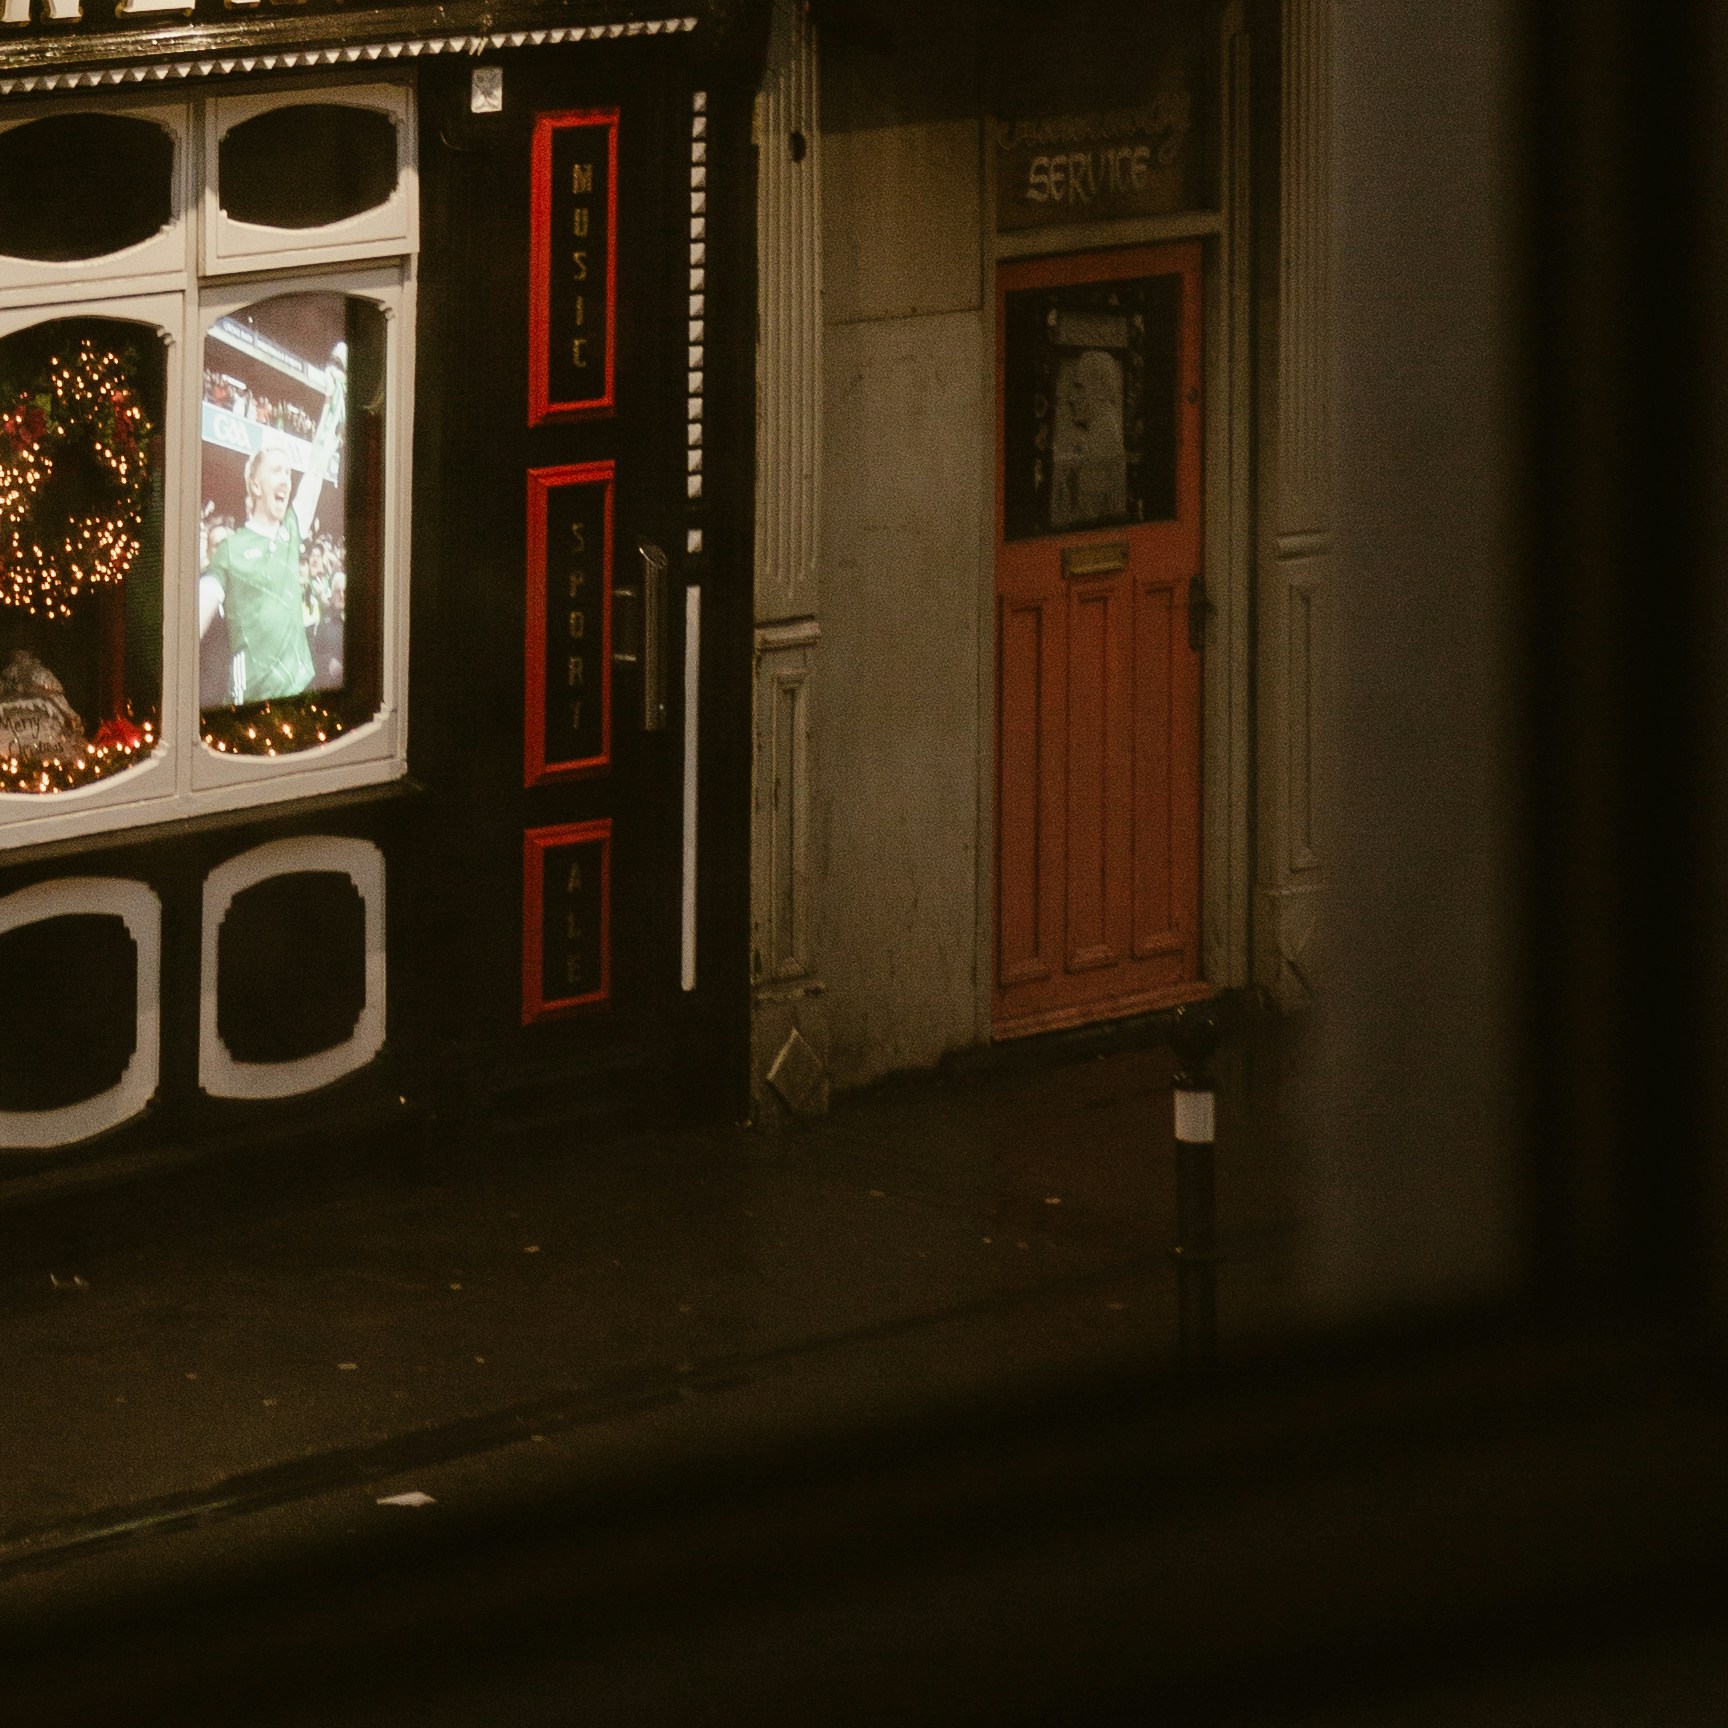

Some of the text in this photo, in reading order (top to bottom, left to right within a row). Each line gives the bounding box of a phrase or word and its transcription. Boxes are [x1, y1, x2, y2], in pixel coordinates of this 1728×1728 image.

[1025, 145, 1152, 205] SERVICE
[571, 162, 594, 370] MUSIC
[567, 521, 587, 731] SPORT
[565, 861, 584, 984] ALE
